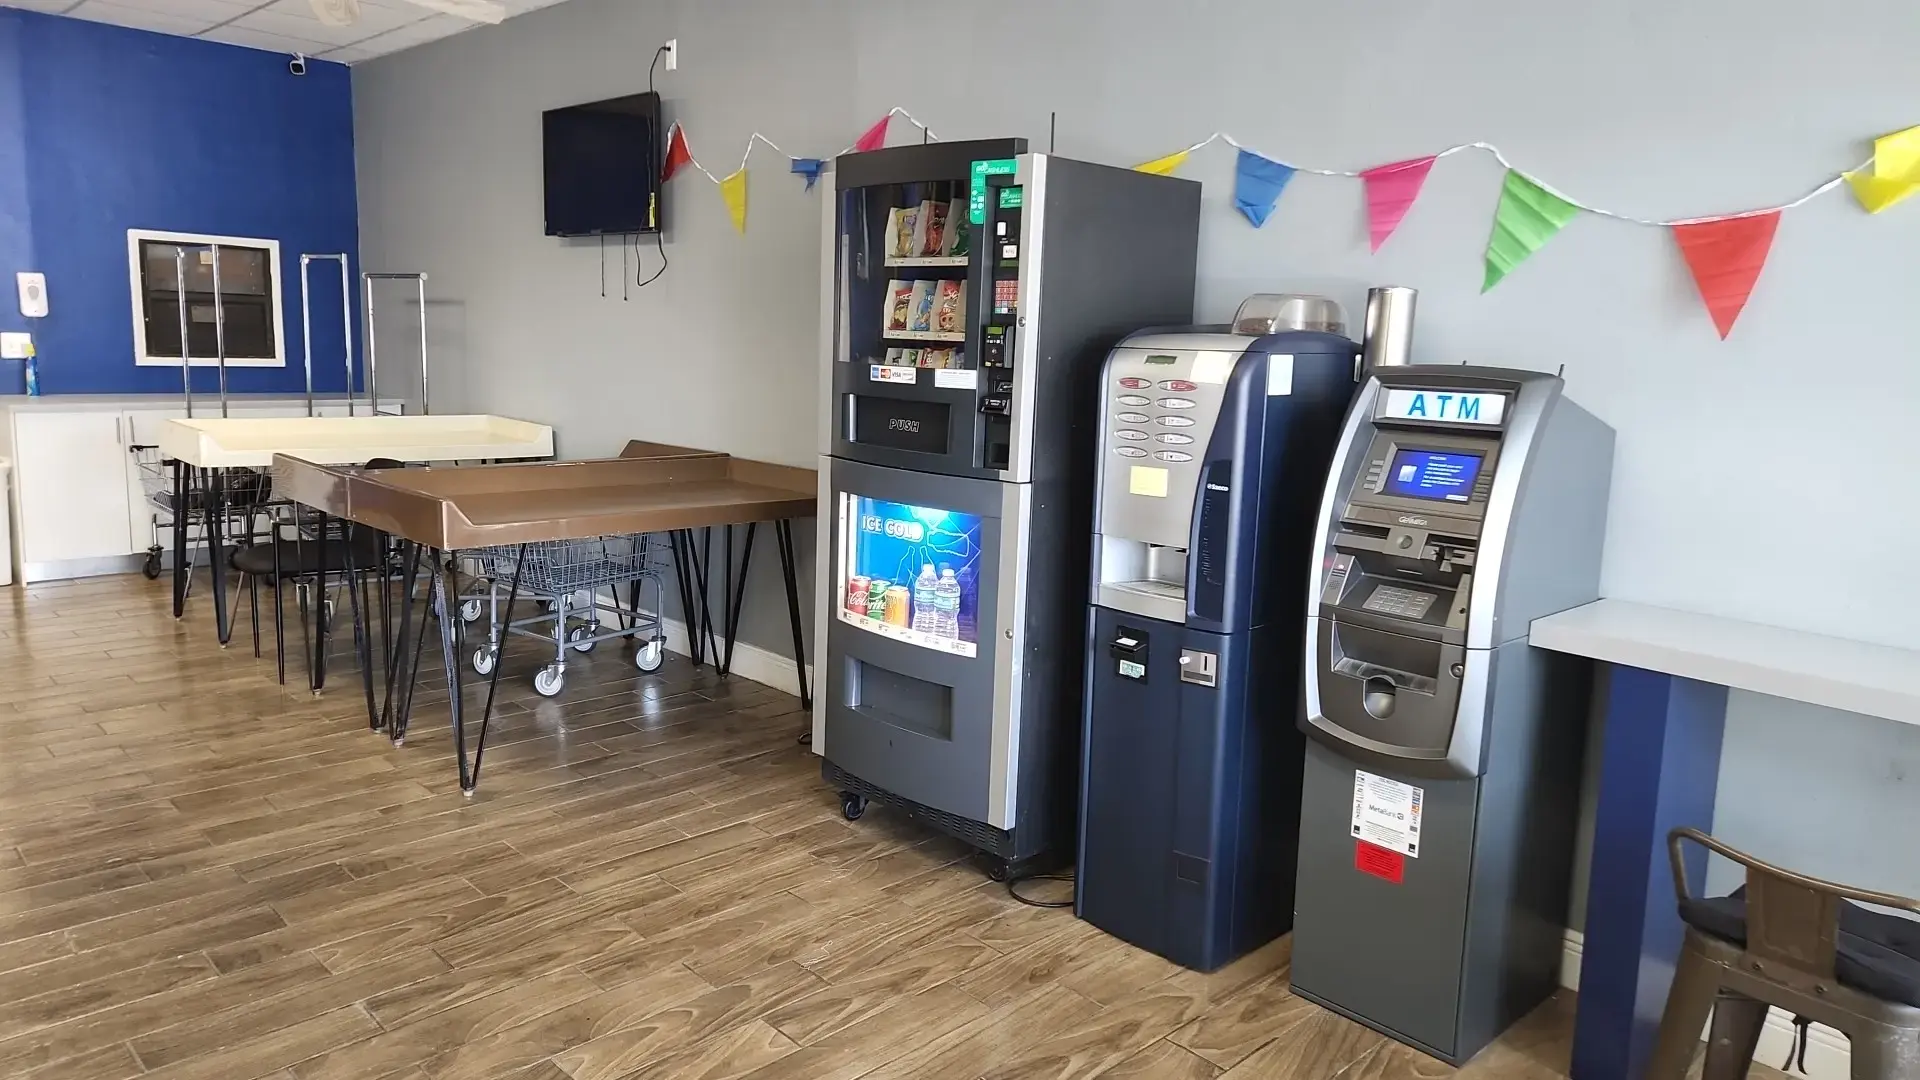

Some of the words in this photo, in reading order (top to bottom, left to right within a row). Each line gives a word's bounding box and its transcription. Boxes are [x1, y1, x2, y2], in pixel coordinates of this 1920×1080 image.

[1408, 394, 1480, 420] ATM
[889, 419, 920, 432] PUSH
[862, 515, 883, 532] ICE
[885, 519, 924, 542] COLD
